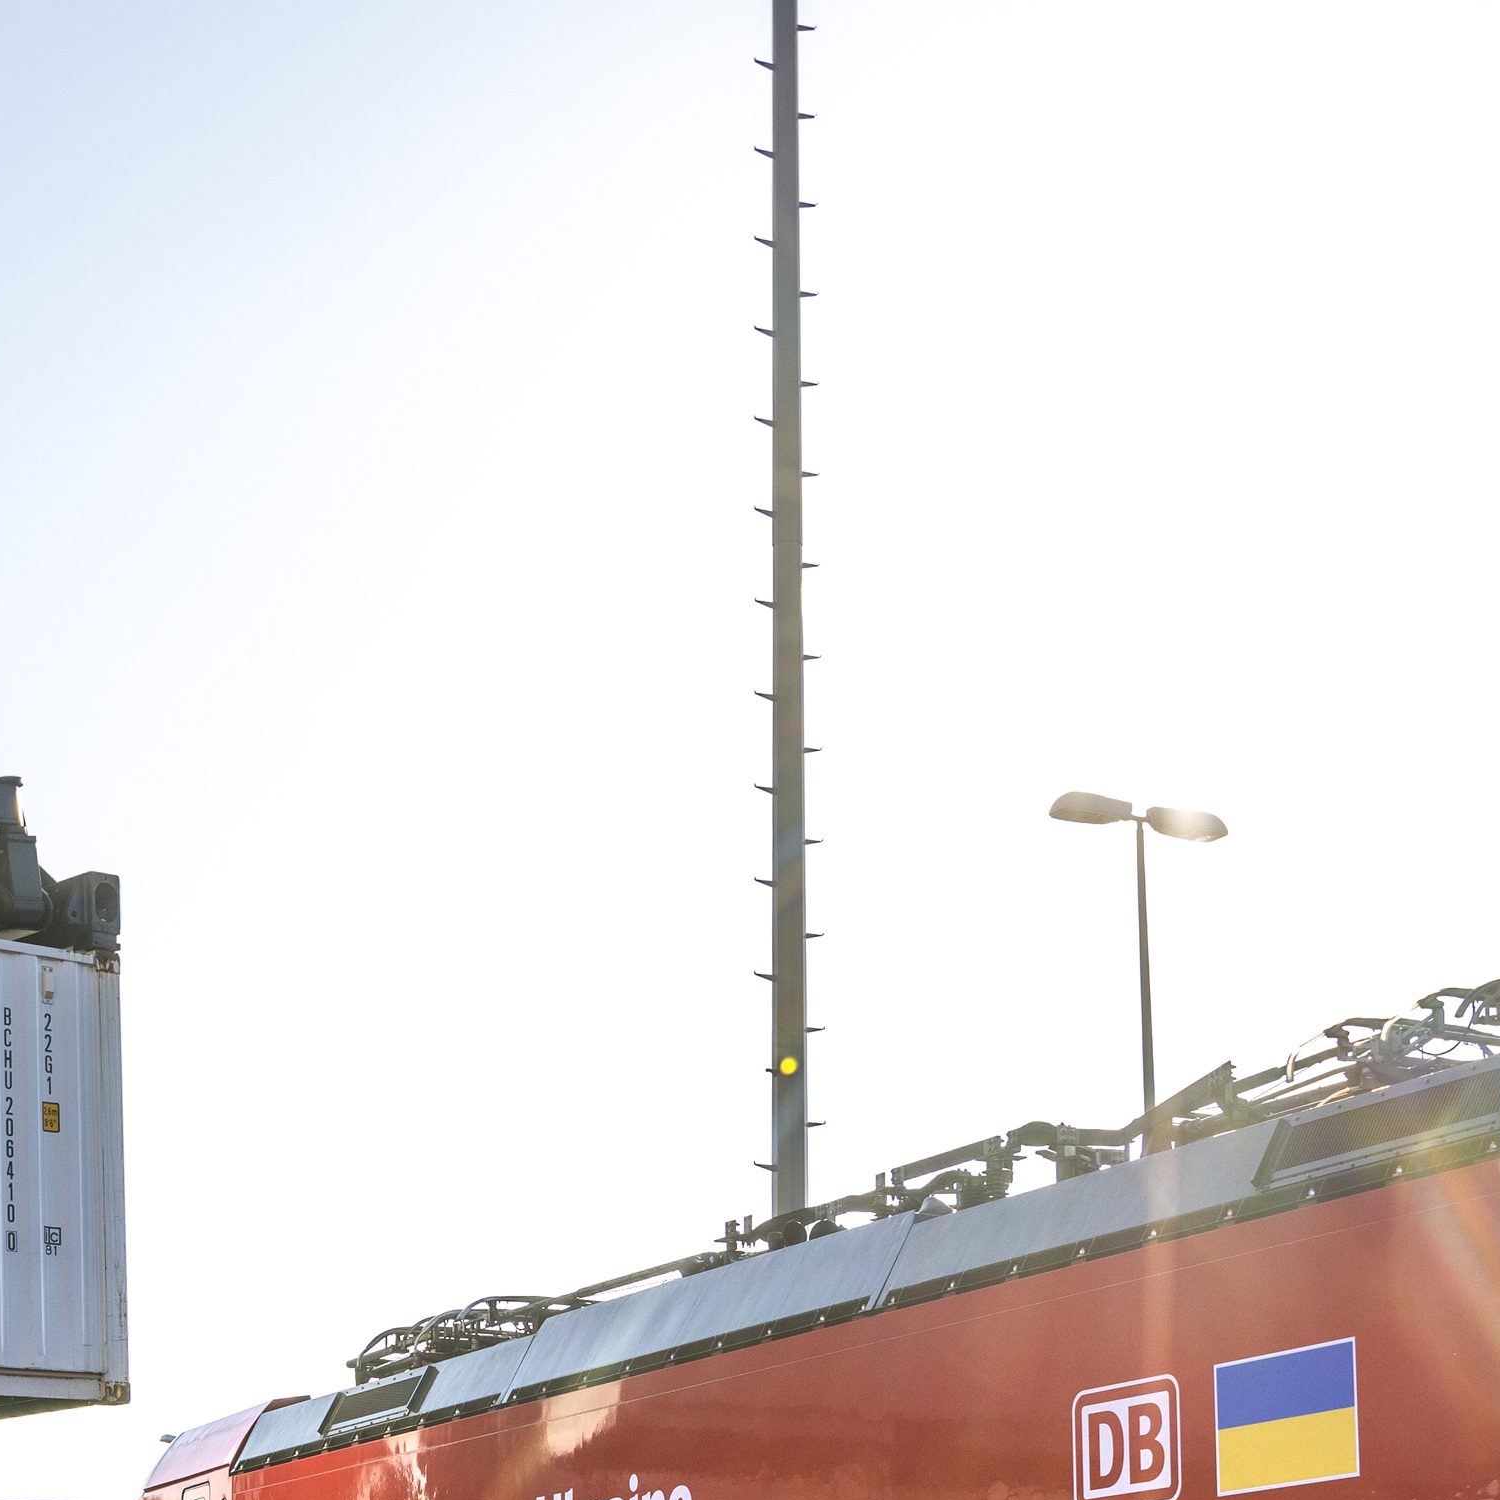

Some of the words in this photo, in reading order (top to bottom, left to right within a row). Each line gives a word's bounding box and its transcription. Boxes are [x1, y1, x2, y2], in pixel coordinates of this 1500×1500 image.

[3, 1007, 13, 1090] BCHU
[44, 1013, 53, 1095] 22G1
[5, 1097, 15, 1223] 206410
